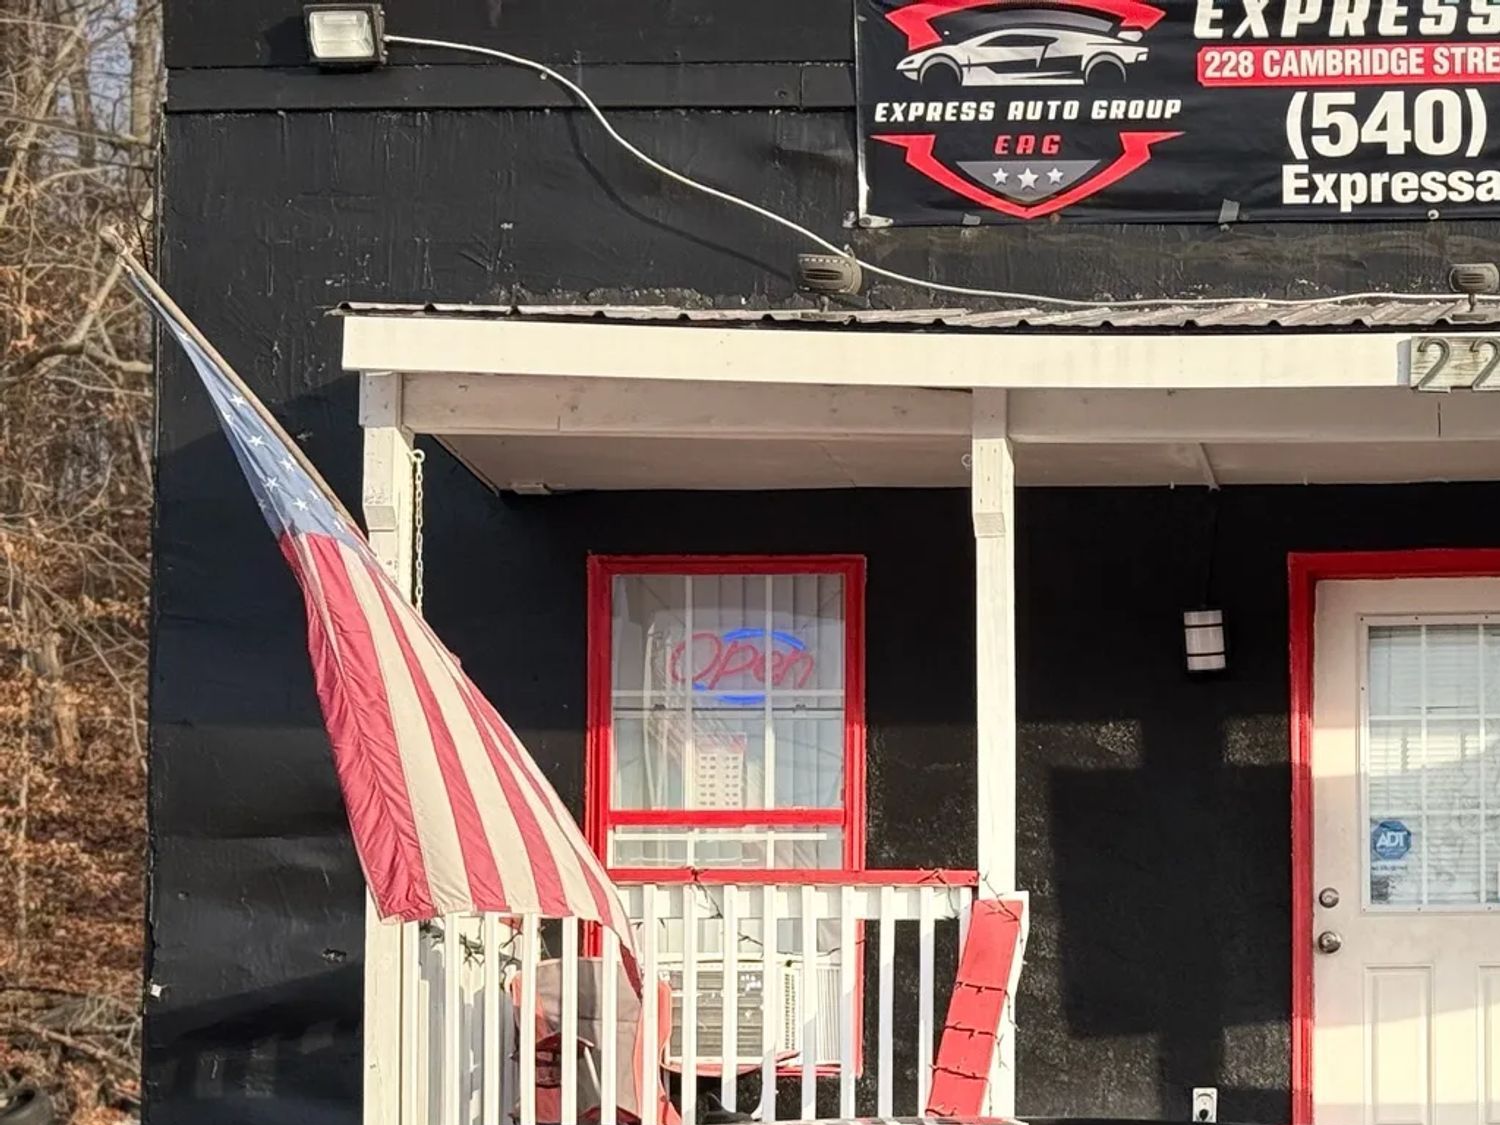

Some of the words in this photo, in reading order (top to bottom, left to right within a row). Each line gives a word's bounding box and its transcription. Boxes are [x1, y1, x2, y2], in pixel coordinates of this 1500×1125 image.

[1204, 50, 1254, 78] 228
[1262, 48, 1425, 77] CAMBRIDGE
[874, 101, 996, 122] EXPRESS
[1007, 100, 1081, 120] AUTO
[1091, 99, 1182, 119] GROUP
[1286, 87, 1488, 160] (540)
[994, 134, 1062, 155] EAG
[1376, 831, 1409, 848] ADT
